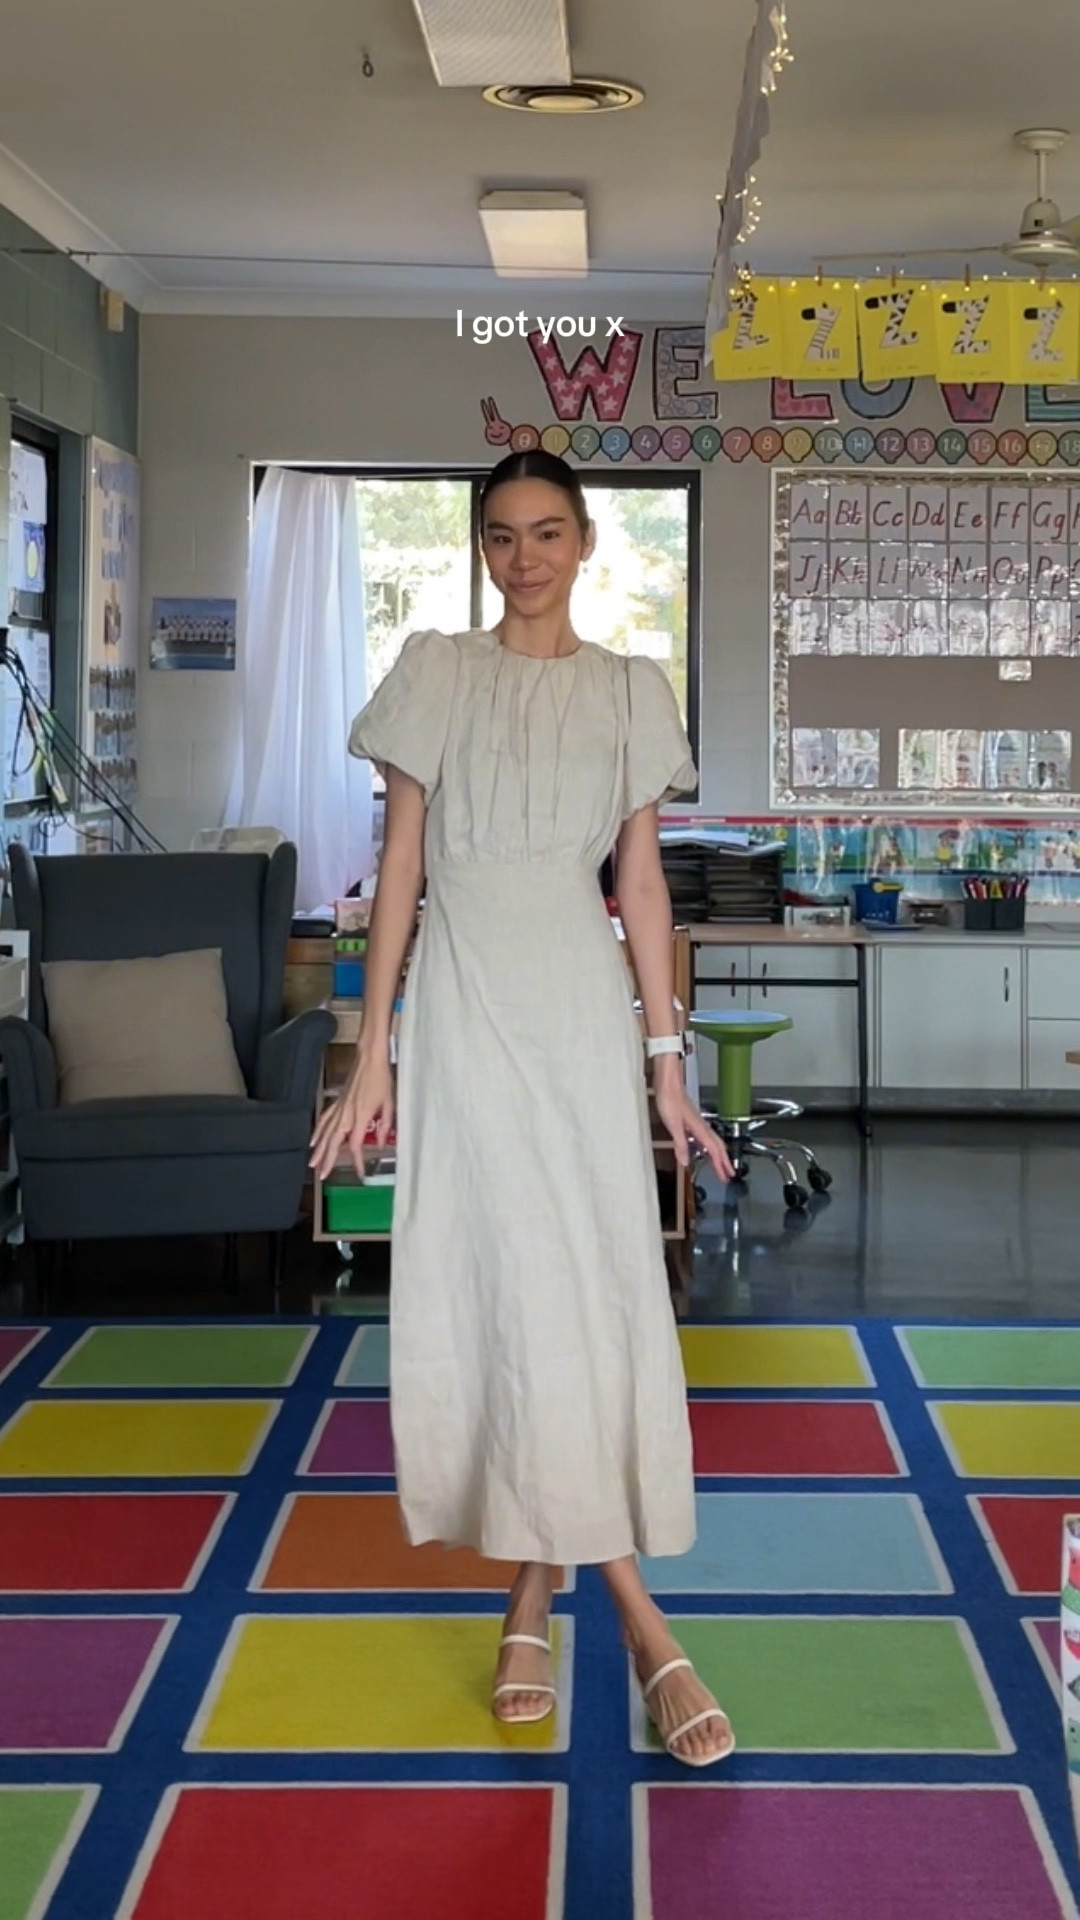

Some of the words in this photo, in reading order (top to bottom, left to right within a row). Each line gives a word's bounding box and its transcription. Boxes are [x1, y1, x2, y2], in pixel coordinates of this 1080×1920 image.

[526, 323, 719, 421] WE
[518, 433, 530, 448] 0
[580, 434, 591, 448] 2
[610, 434, 621, 449] 3
[639, 434, 651, 448] 4
[671, 435, 682, 449] 5
[701, 433, 712, 449] 6
[732, 436, 742, 450] 7
[761, 435, 772, 449] 8
[817, 437, 836, 451] 10
[882, 436, 900, 452] 12
[911, 437, 930, 451] 13
[942, 437, 961, 452] 14
[972, 438, 991, 453] 15
[1003, 438, 1022, 453] 16
[1063, 438, 1080, 453] 18
[792, 498, 824, 525] Aa
[835, 499, 864, 526] Bb
[872, 500, 904, 527] Cc
[912, 501, 945, 527] Dd
[954, 501, 983, 528] Ee
[993, 501, 1027, 529] Ff
[1033, 501, 1066, 540] Gg
[794, 555, 823, 594] Jj
